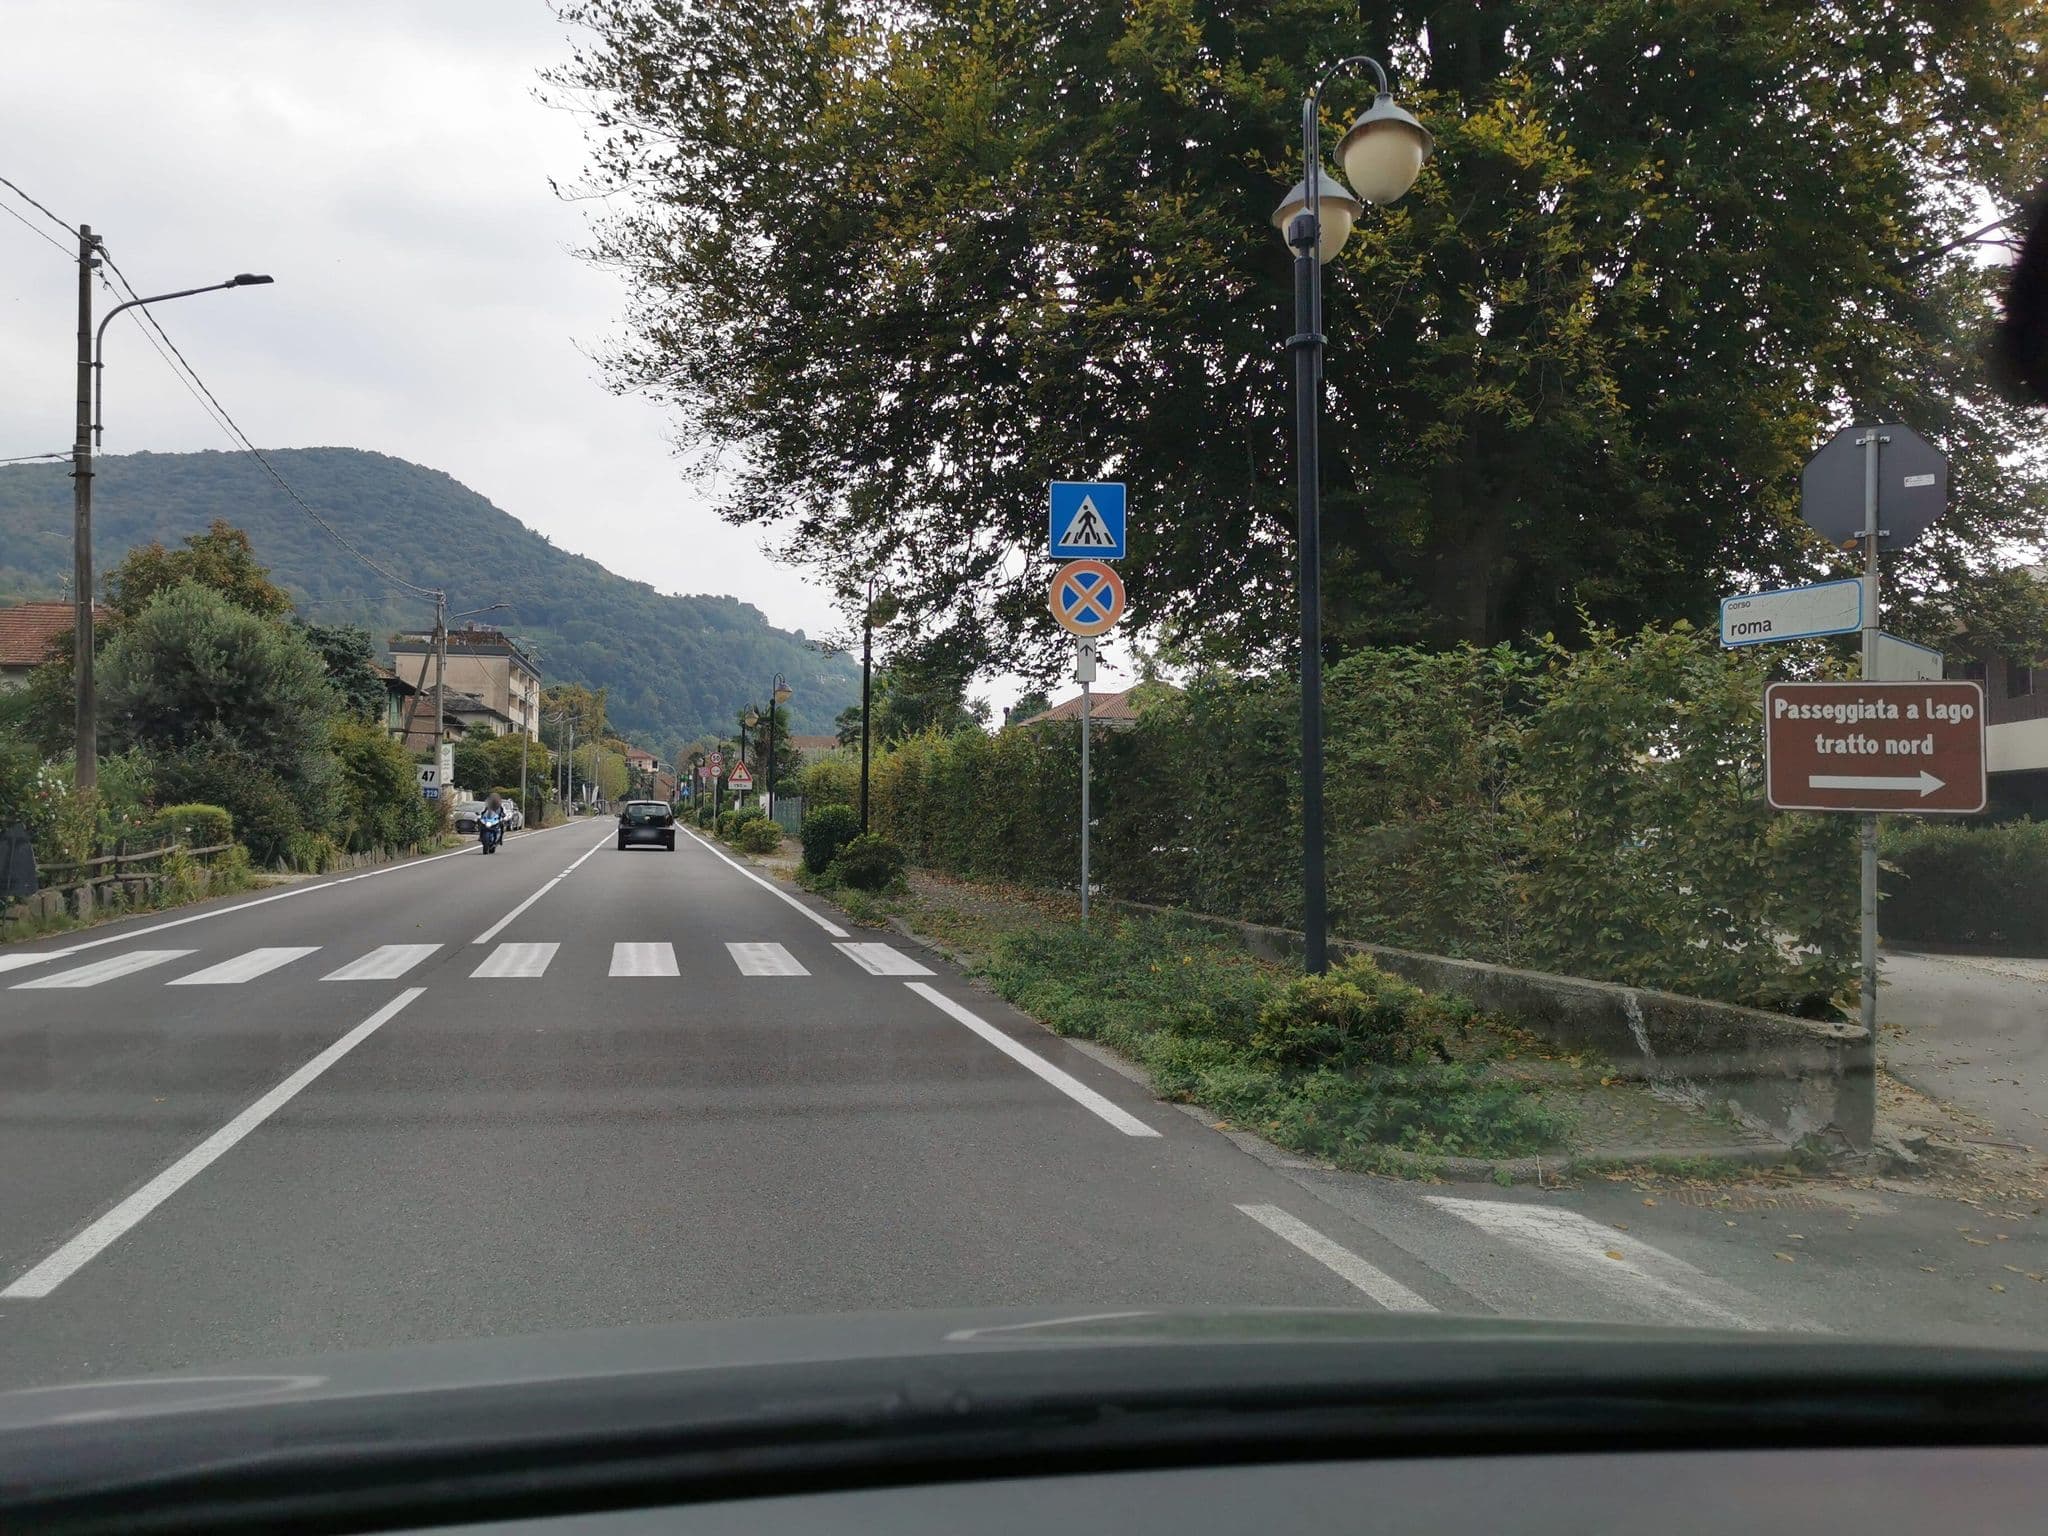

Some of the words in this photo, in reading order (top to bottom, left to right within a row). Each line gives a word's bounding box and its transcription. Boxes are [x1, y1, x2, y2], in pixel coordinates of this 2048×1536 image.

[1727, 601, 1751, 610] corso
[1731, 620, 1772, 636] roma
[1774, 698, 1899, 724] Passeggiata
[1906, 703, 1920, 720] a
[1814, 733, 1879, 755] tratto
[1884, 733, 1934, 755] nord
[421, 770, 435, 782] 47
